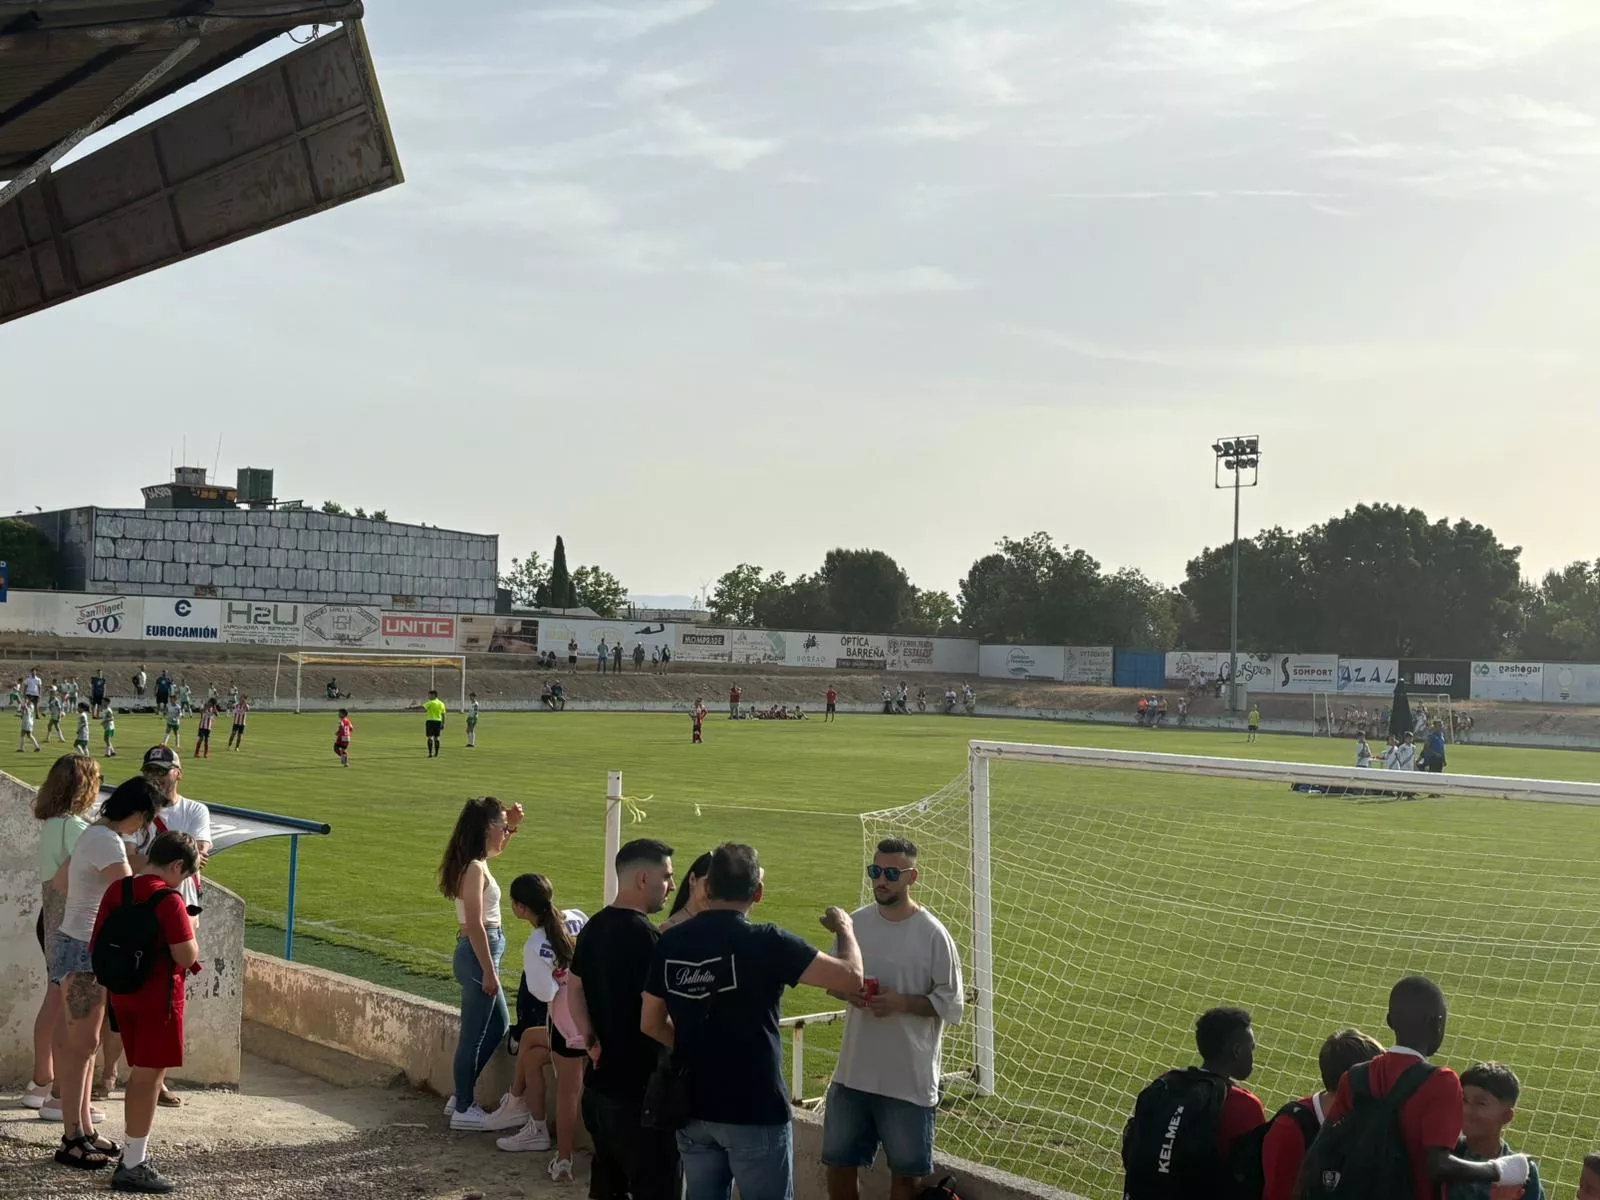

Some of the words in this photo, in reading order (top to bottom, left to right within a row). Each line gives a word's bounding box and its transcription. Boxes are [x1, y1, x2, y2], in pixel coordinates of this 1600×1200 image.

[79, 608, 96, 620] San
[96, 601, 123, 616] Miguel
[227, 602, 298, 626] H2U
[145, 624, 218, 639] EUROCAMIÓN
[386, 619, 450, 634] UNITIC
[1293, 668, 1332, 677] SOMPORT
[1341, 665, 1396, 683] AZAL
[1158, 1115, 1181, 1174] KELME
